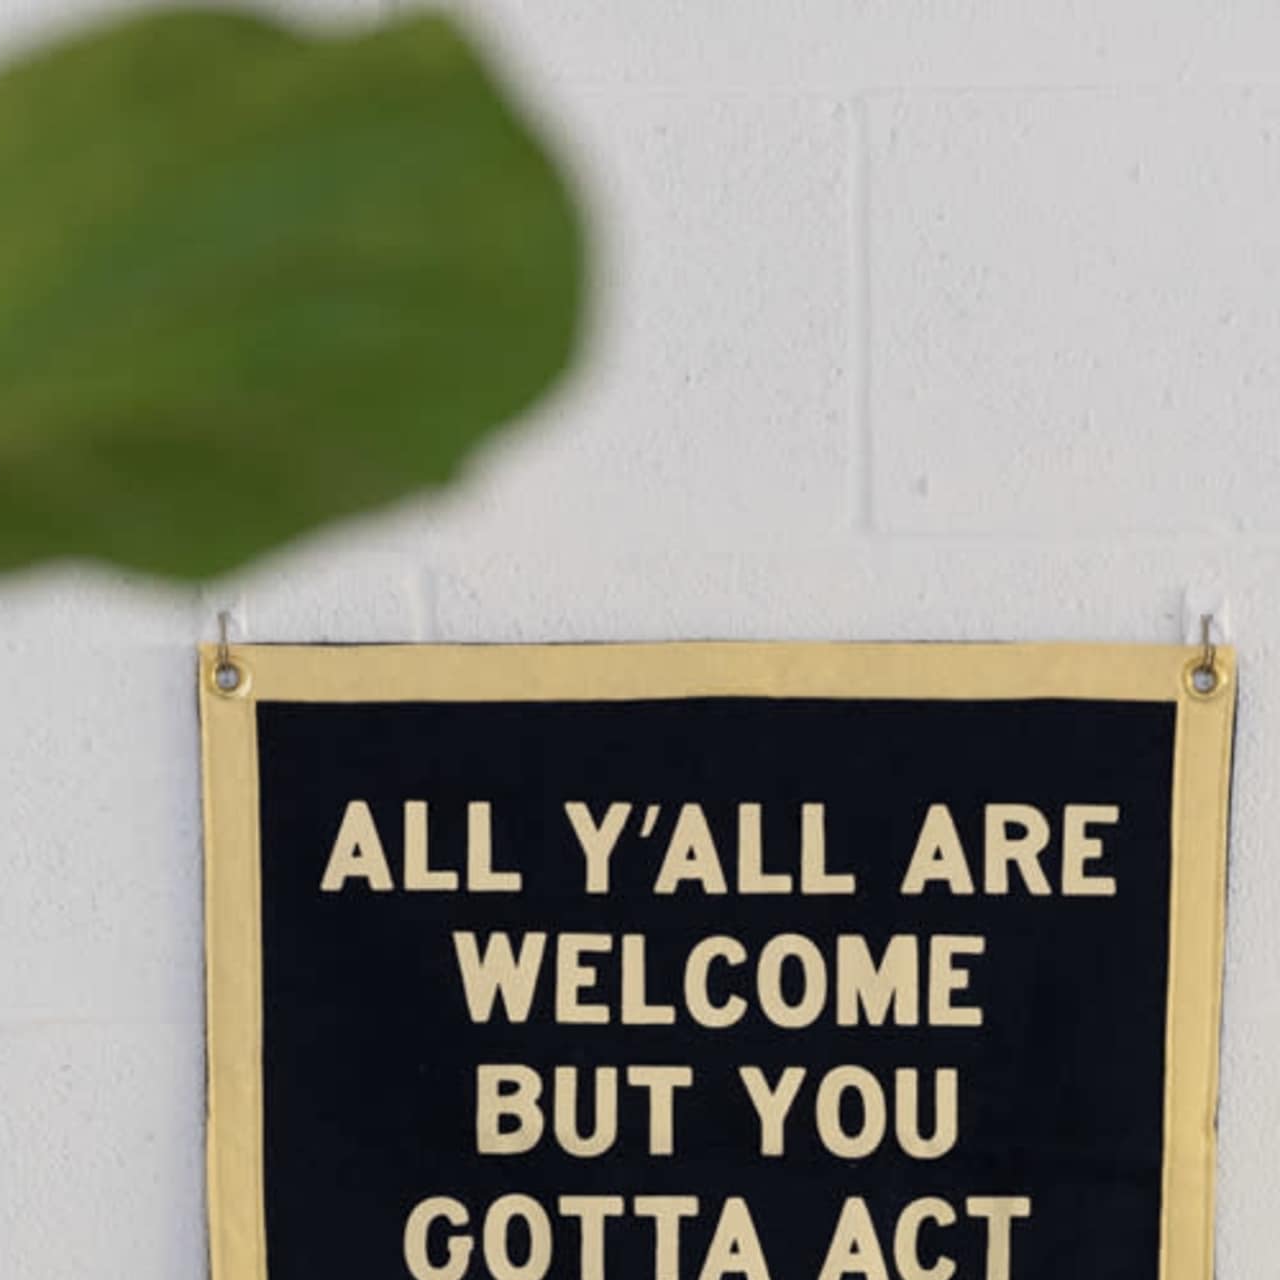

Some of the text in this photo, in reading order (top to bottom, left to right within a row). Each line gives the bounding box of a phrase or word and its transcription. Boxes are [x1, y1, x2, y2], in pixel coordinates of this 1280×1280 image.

[320, 800, 1119, 896] ALL Y'ALL ARE
[453, 931, 985, 1028] WELCOME
[476, 1064, 958, 1159] BUT YOU
